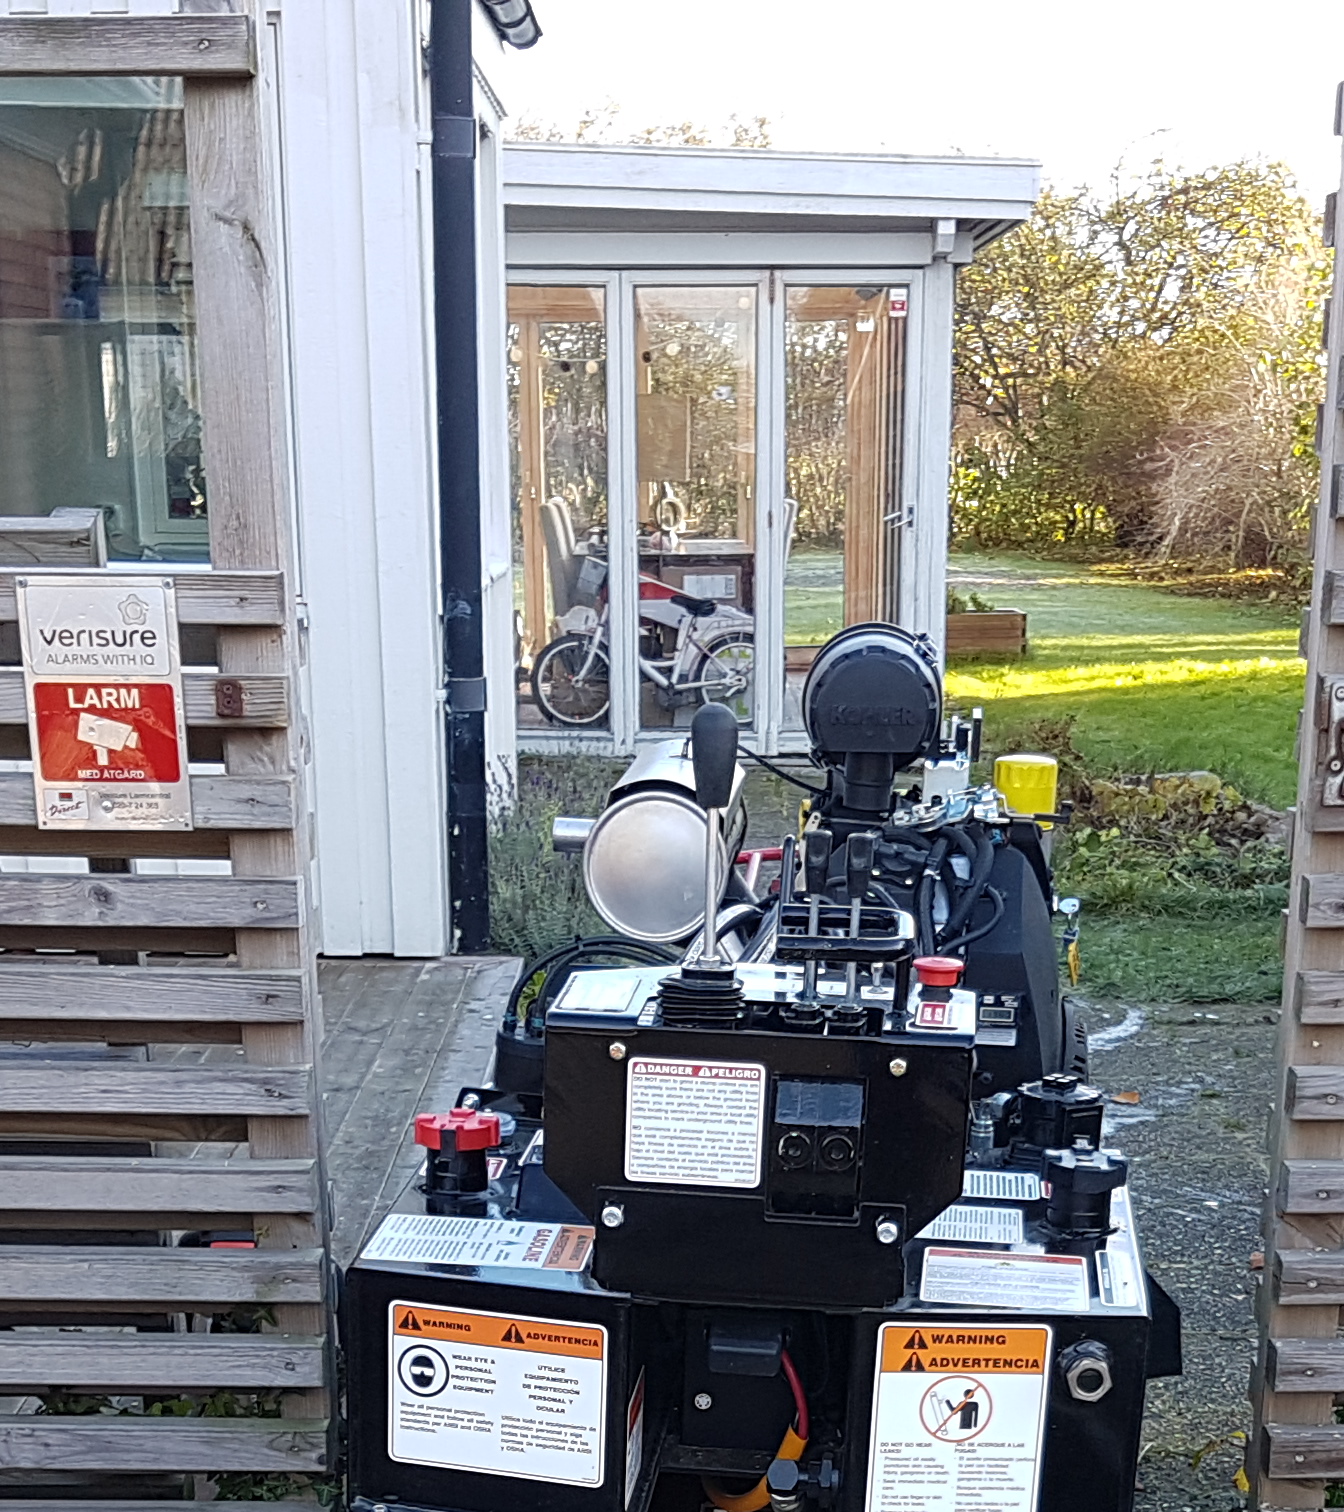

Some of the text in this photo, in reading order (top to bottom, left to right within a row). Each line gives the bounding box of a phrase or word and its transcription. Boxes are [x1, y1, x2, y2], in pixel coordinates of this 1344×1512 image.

[39, 629, 157, 647] verisure
[46, 654, 155, 666] ALARMS WITH IQ
[67, 687, 140, 709] LARM
[78, 770, 100, 778] MED
[648, 1065, 692, 1075] DANGER
[712, 1068, 759, 1078] PELIGRO
[522, 1228, 553, 1263] GASOLINE
[422, 1319, 471, 1332] WARNING
[526, 1332, 599, 1347] ADVERTENCIA
[930, 1334, 1006, 1345] WARNING
[928, 1357, 1040, 1369] ADVERTENCIA
